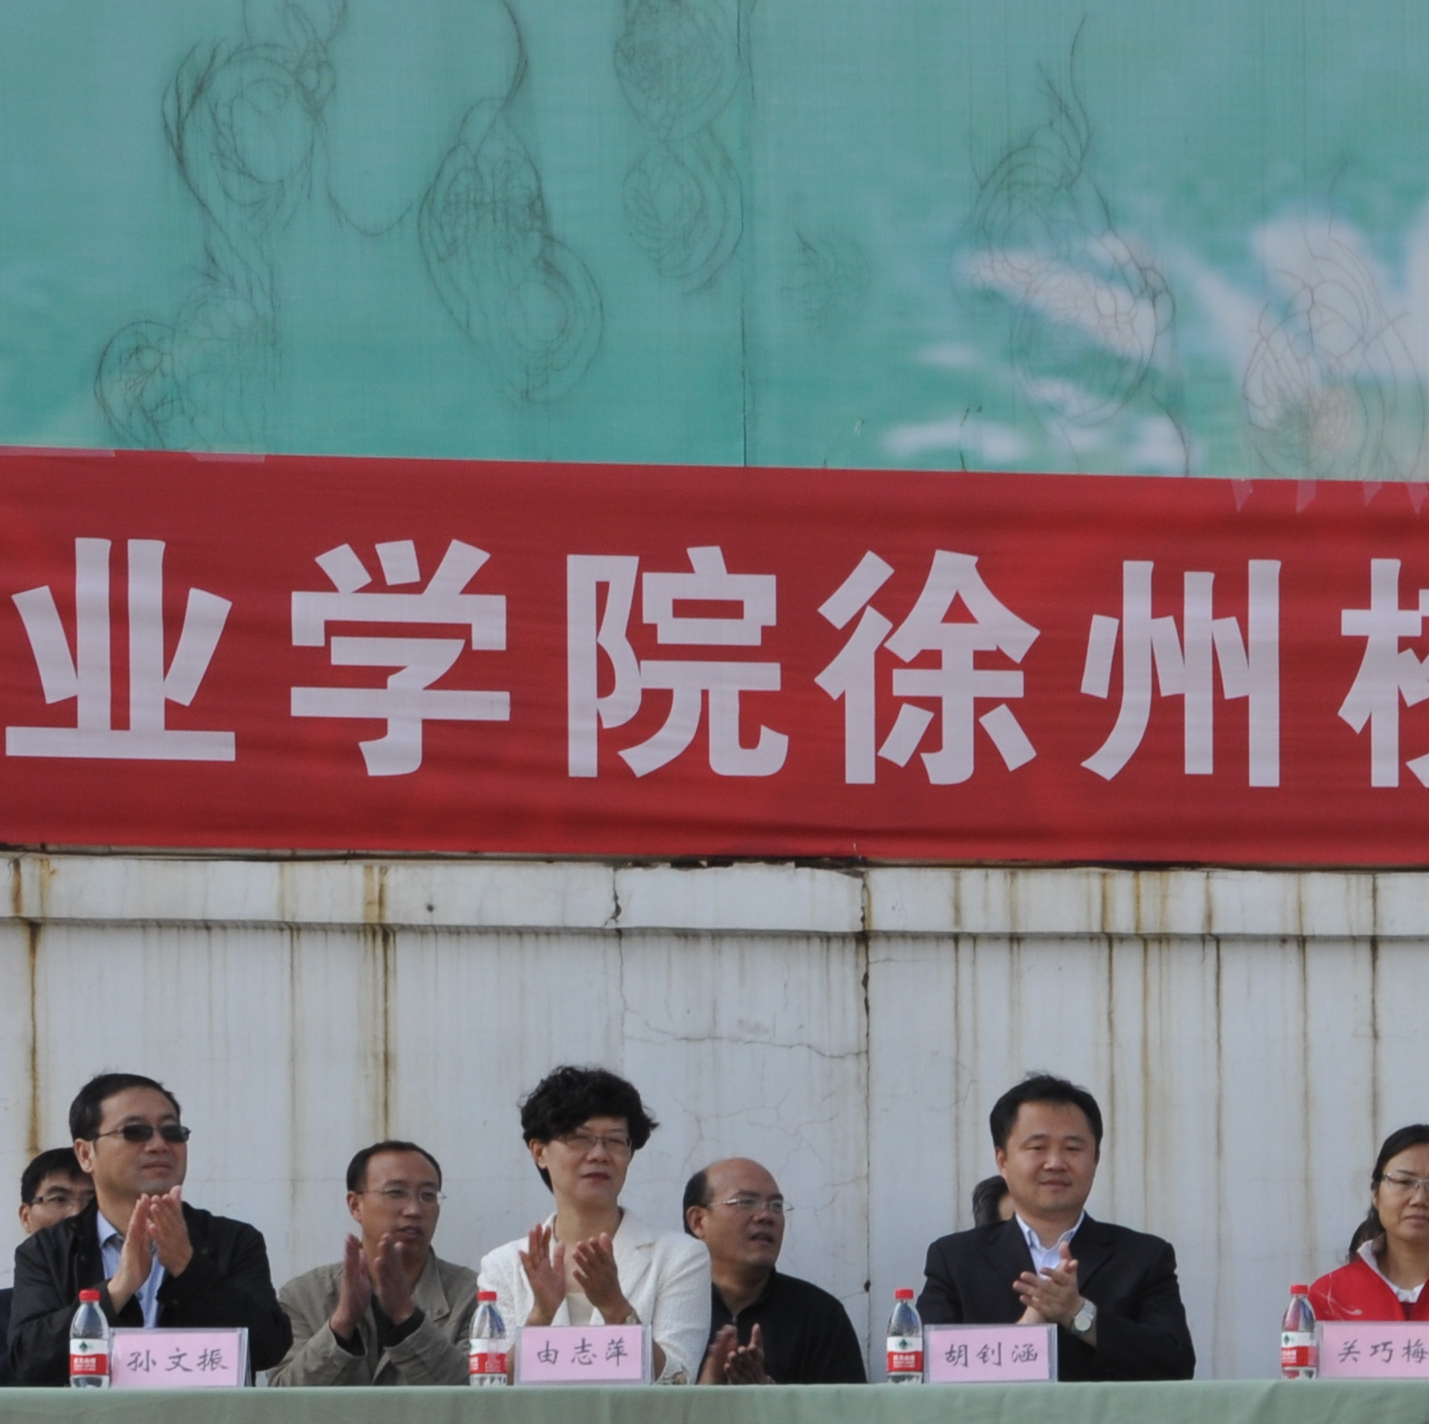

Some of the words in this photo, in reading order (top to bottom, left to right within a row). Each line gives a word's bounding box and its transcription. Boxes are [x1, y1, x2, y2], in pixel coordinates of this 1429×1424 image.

[125, 1347, 228, 1373] 孙文振
[535, 1336, 629, 1365] 由志萍
[1337, 1338, 1429, 1364] 关巧梅
